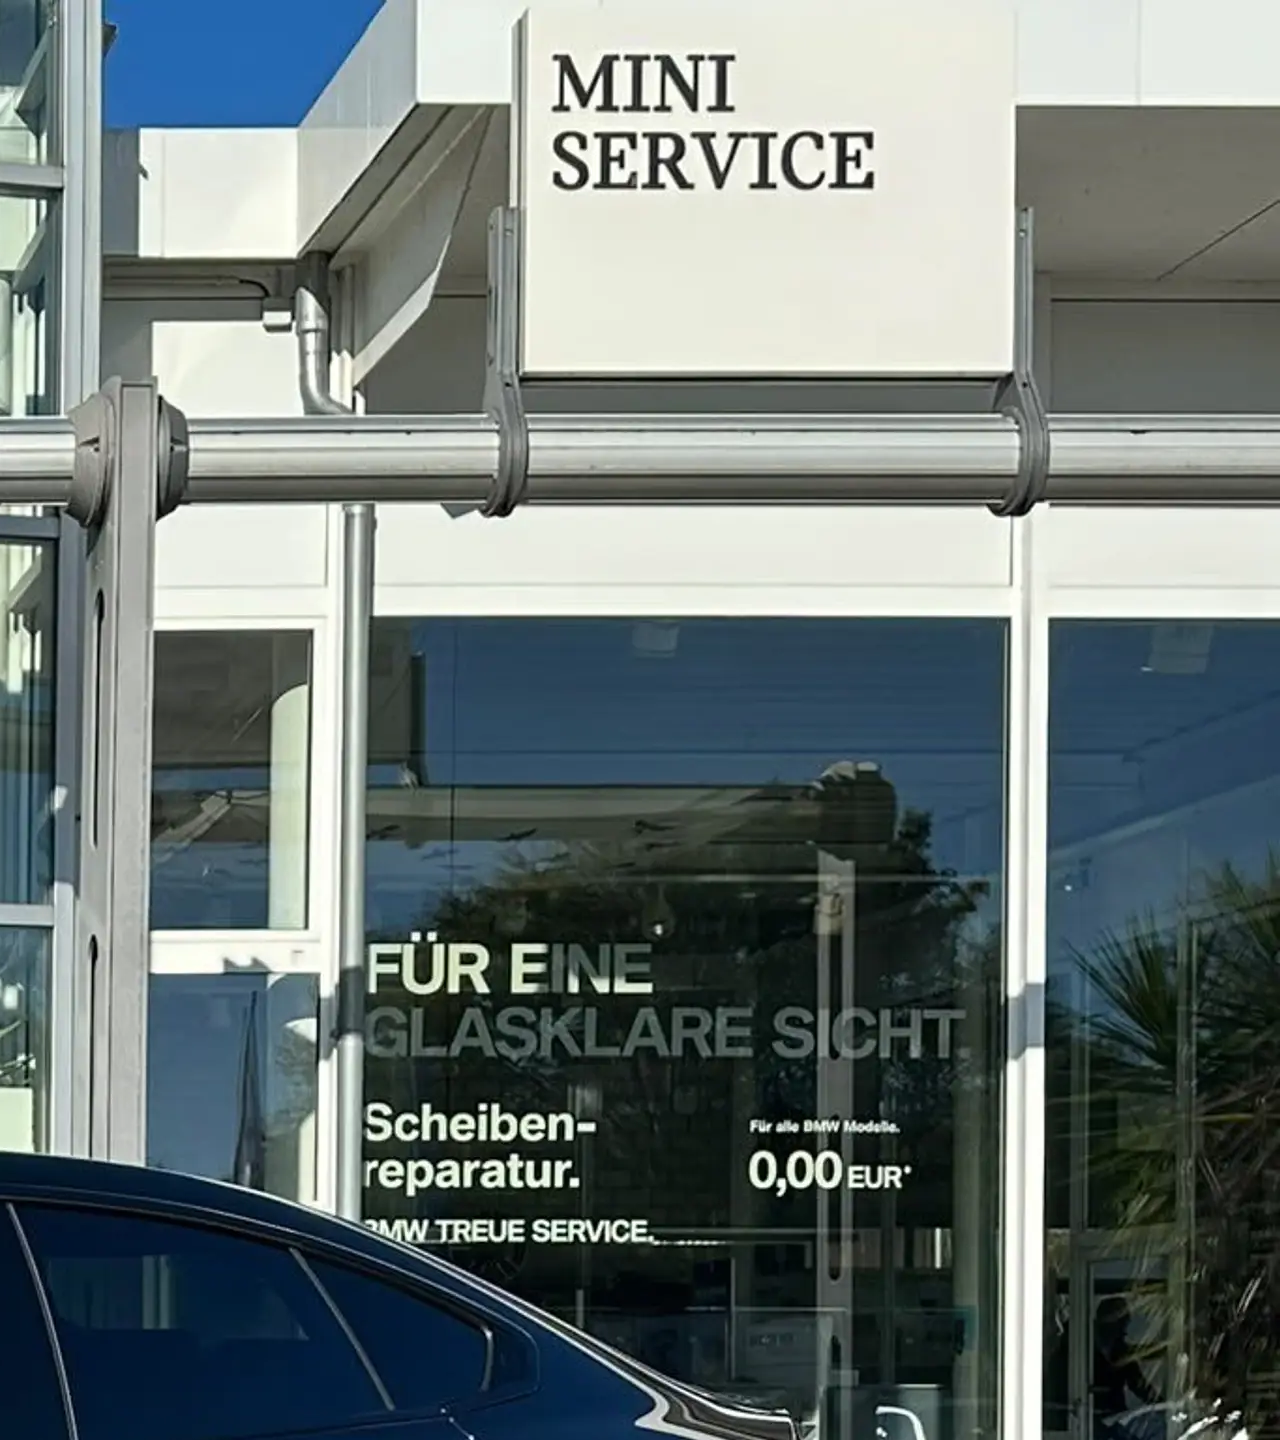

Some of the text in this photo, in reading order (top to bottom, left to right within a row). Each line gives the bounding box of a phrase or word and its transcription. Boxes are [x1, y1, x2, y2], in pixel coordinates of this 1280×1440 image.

[551, 54, 737, 113] MINI
[551, 131, 875, 190] SERVICE
[368, 931, 653, 995] FÜR EINE
[364, 1006, 754, 1060] GLASKLARE
[364, 1102, 597, 1142] Scheiben-
[749, 1119, 901, 1133] Für alle BMW Modelle.
[364, 1152, 580, 1198] reparatur.
[748, 1149, 843, 1198] 0,00
[434, 1218, 526, 1243] TREUE
[530, 1218, 655, 1243] SERVICE.
